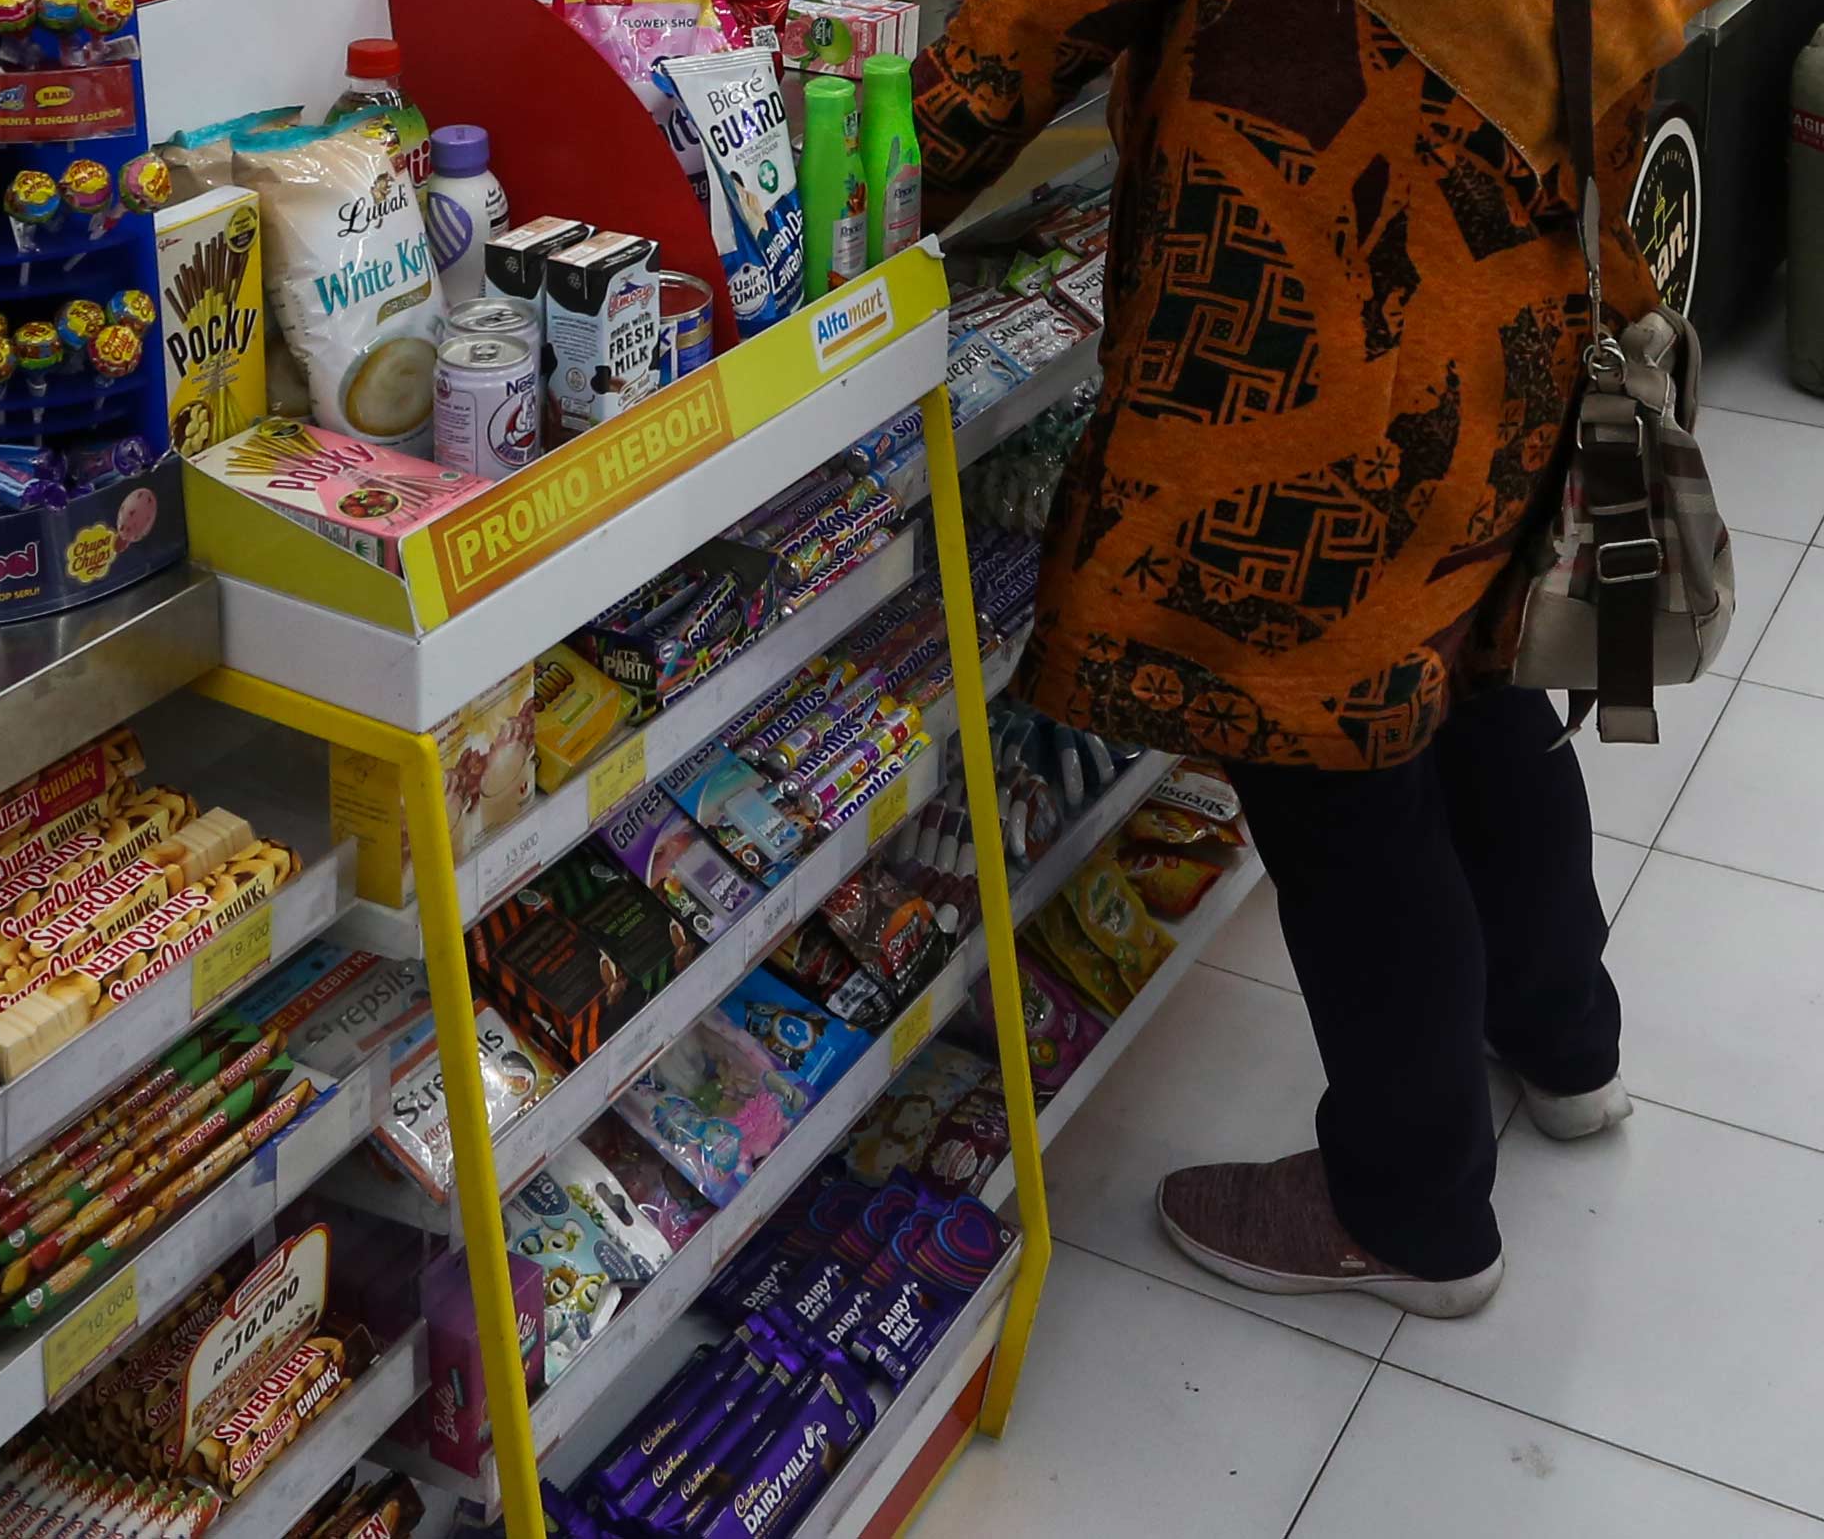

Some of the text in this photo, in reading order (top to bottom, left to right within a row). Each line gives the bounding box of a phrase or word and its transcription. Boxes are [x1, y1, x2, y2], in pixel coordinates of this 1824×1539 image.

[709, 92, 786, 157] GUARD
[338, 184, 410, 238] Luwak
[315, 258, 396, 317] White
[734, 274, 759, 293] Usir
[817, 288, 884, 345] Alfamart
[994, 305, 1056, 350] Strepsils
[166, 307, 257, 378] POCKY
[609, 322, 655, 360] FRESH
[614, 346, 649, 376] MILK
[268, 442, 374, 493] POCKY
[455, 399, 713, 577] PROMO HEBOH
[71, 549, 113, 576] Chups
[72, 537, 112, 561] Chupa
[602, 658, 652, 683] PARTY
[884, 637, 940, 693] mentos
[763, 685, 828, 748] mentos
[798, 717, 866, 780] mentos
[39, 765, 98, 804] CHUNKY
[838, 761, 904, 822] mentos
[47, 804, 101, 847] CHUNKY
[108, 823, 163, 868] CHUNKY
[312, 963, 351, 999] LEBIH
[305, 967, 416, 1045] Strepsils
[795, 1277, 833, 1317] DAIRY
[877, 1296, 912, 1337] DAIRY
[826, 1305, 864, 1345] DAIRY
[892, 1313, 921, 1348] MILK
[295, 1365, 342, 1419] CHUNKY
[640, 1418, 677, 1457] Cadbury
[651, 1449, 689, 1489] Cadbury
[733, 1476, 771, 1520] Cadbury
